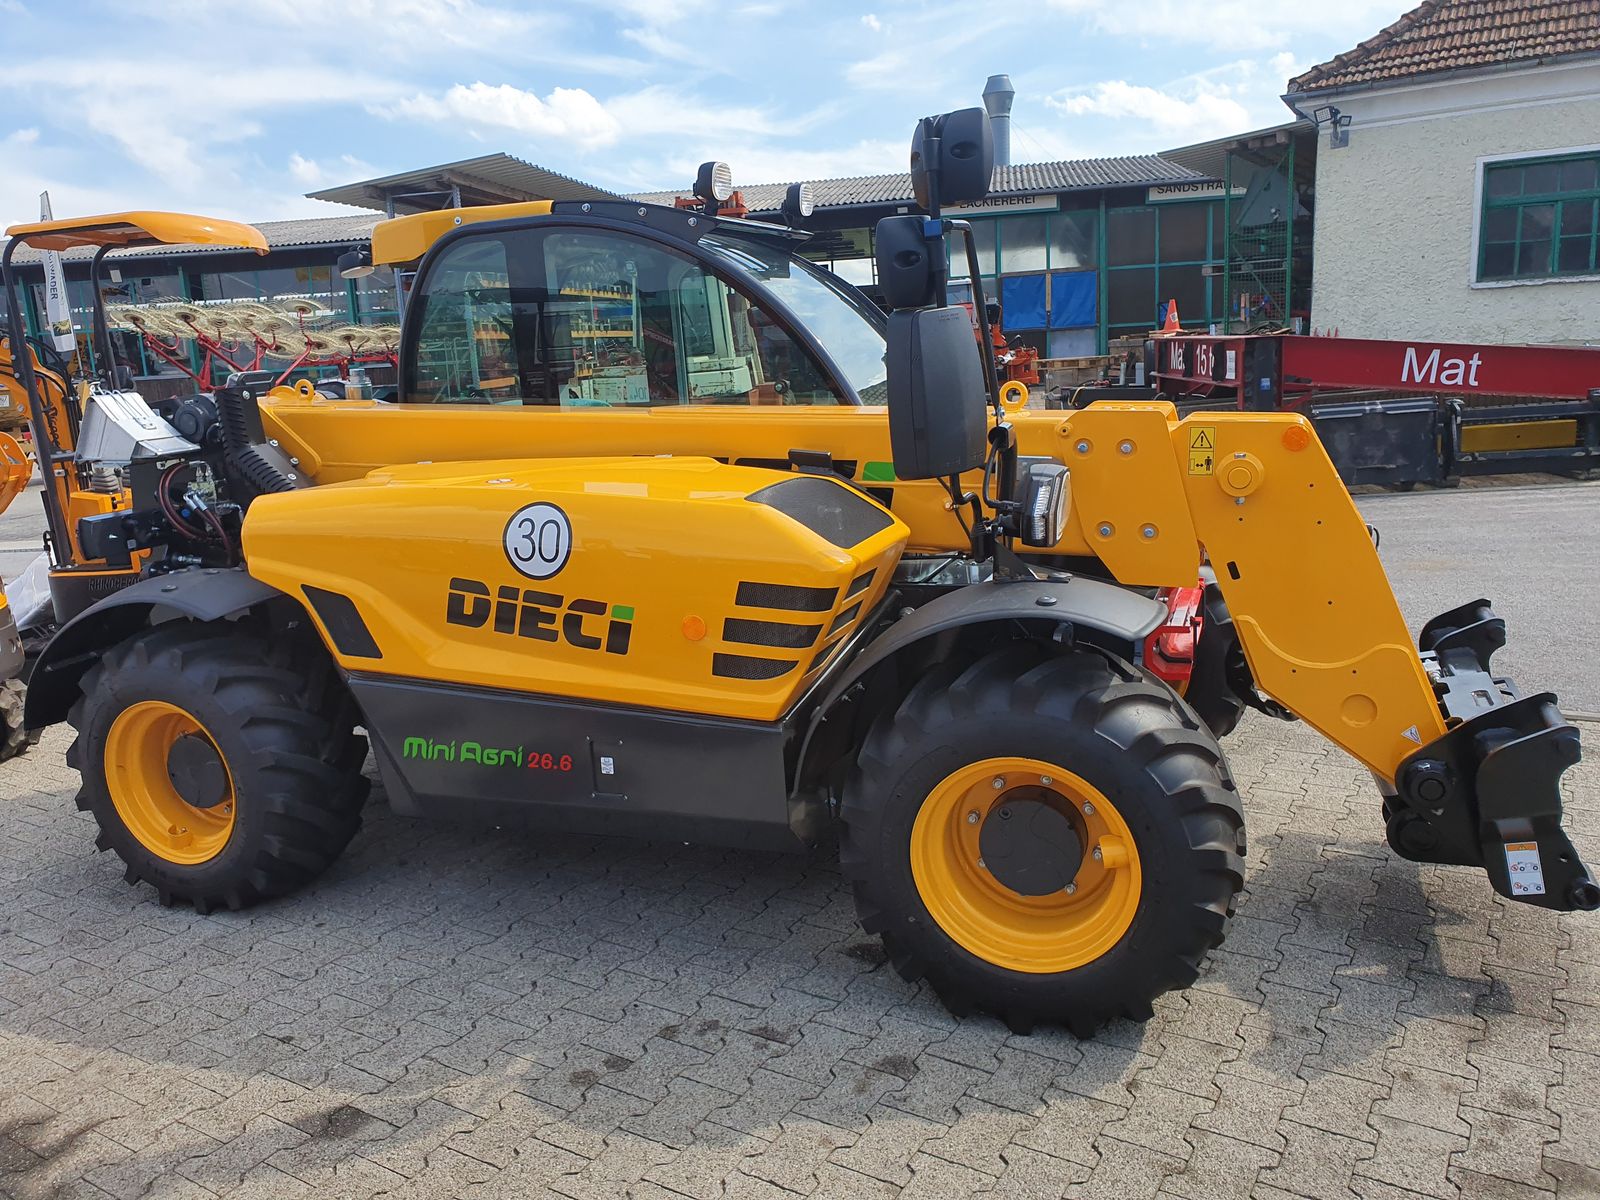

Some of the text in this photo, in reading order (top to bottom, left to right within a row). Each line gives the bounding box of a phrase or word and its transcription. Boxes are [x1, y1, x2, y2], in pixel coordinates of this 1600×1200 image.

[1196, 344, 1207, 375] 15
[1401, 347, 1482, 387] Mat
[514, 518, 561, 564] 30
[446, 577, 635, 656] DIECI
[403, 736, 456, 761] Mini
[460, 741, 524, 767] Agri
[527, 752, 573, 772] 26.6
